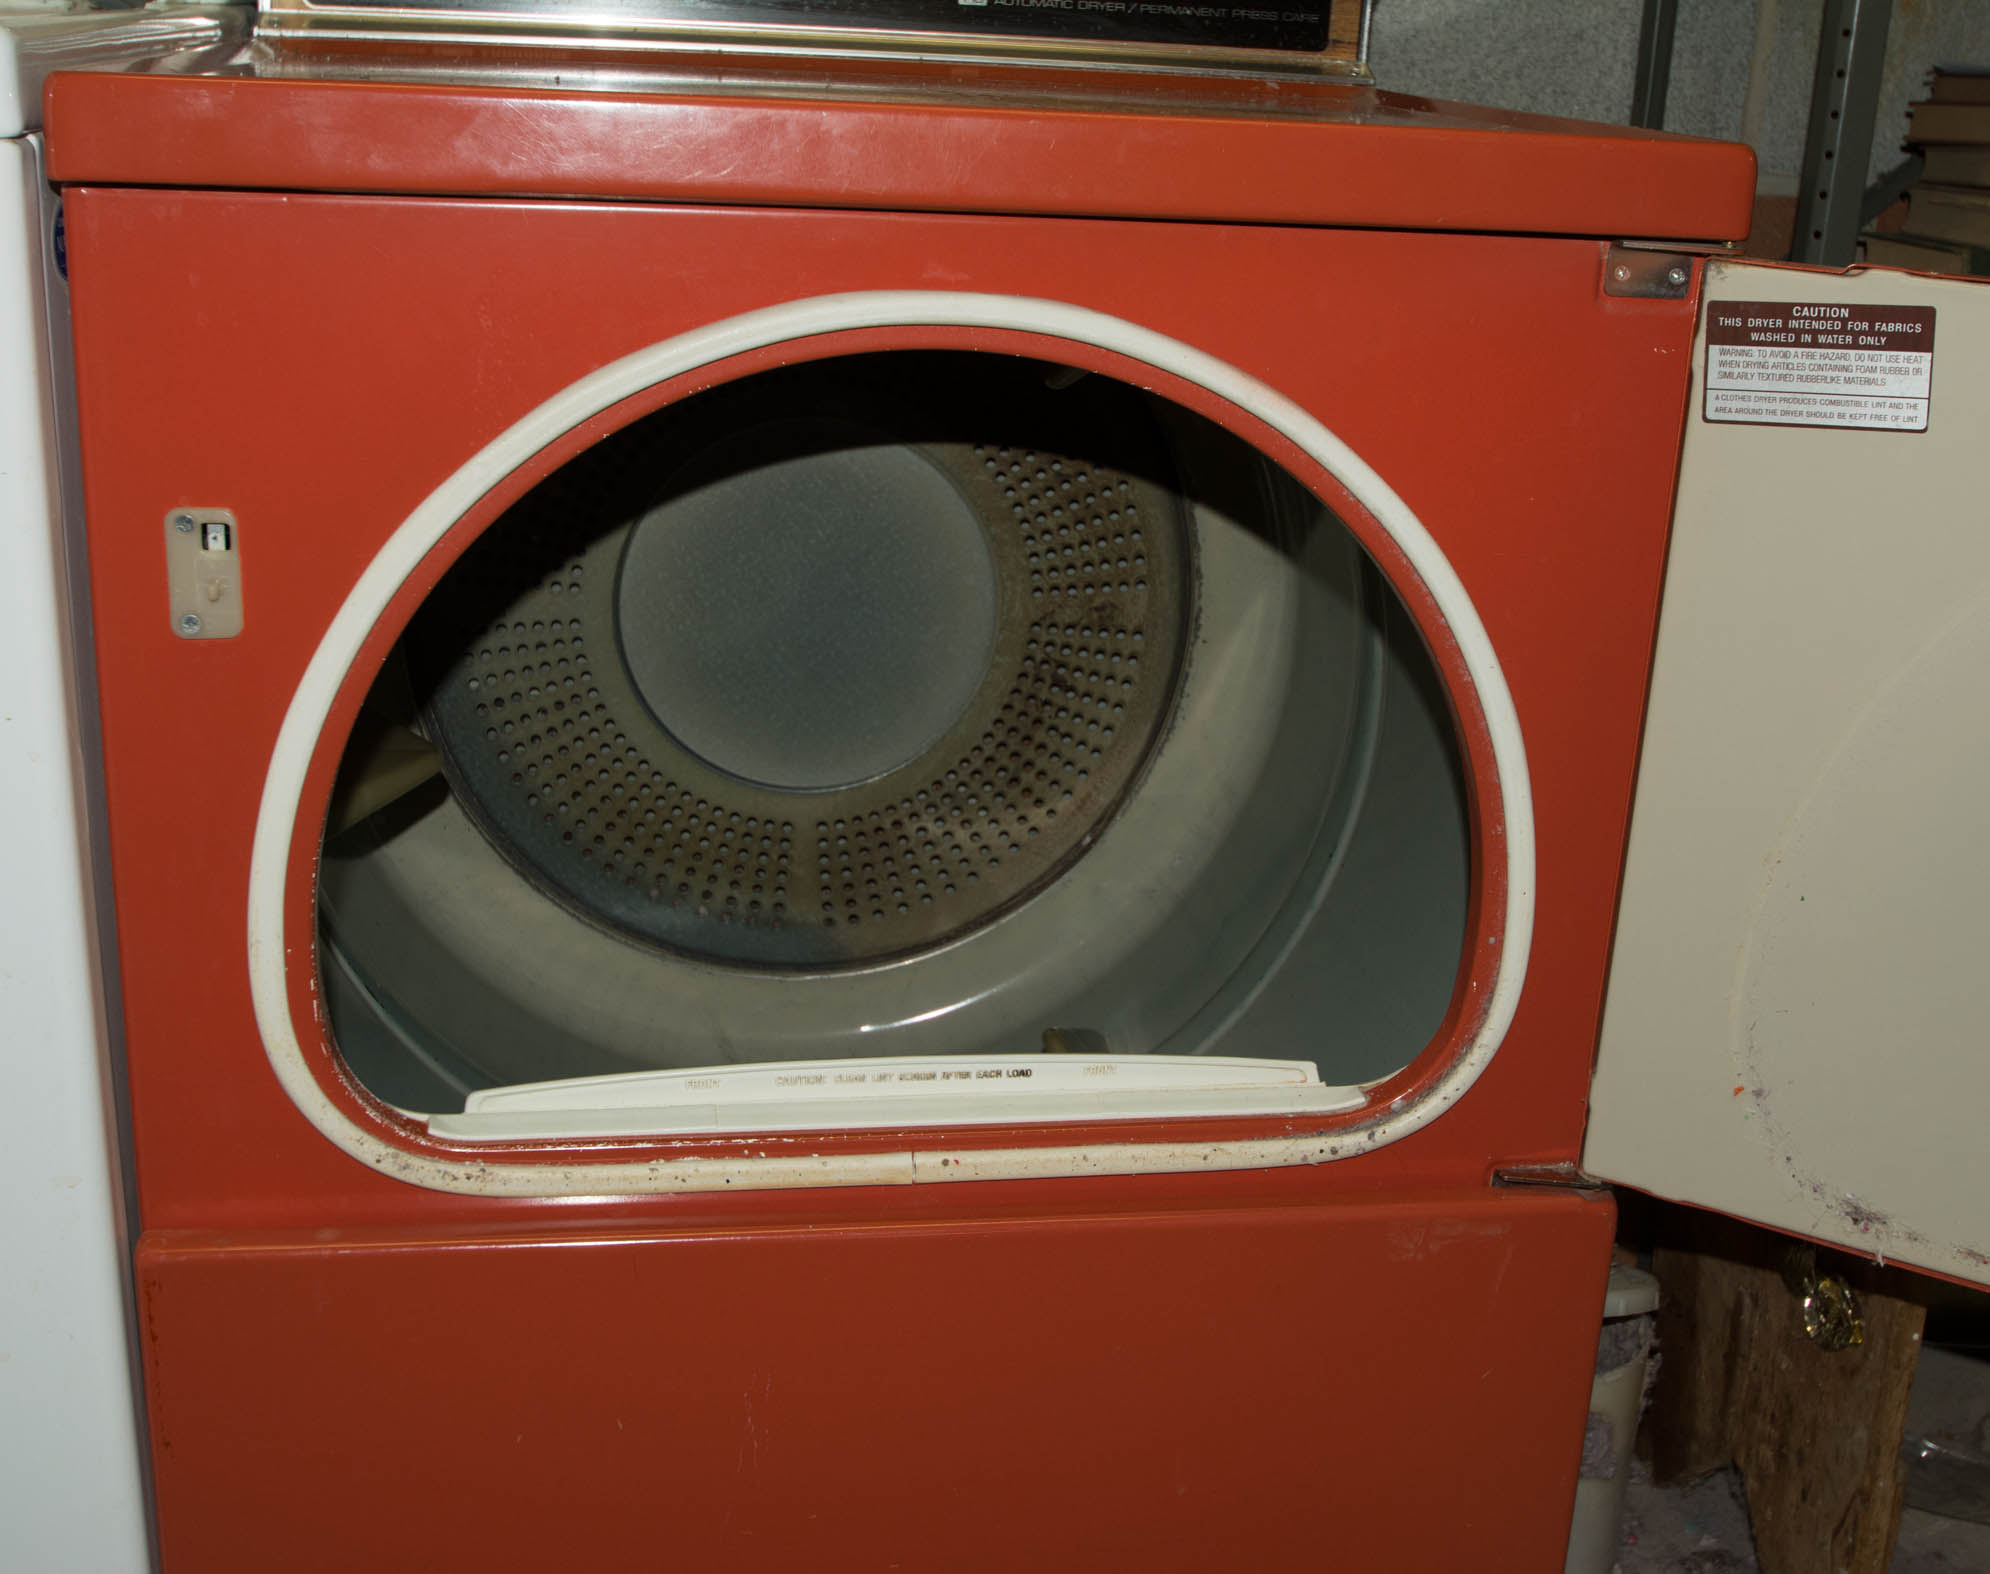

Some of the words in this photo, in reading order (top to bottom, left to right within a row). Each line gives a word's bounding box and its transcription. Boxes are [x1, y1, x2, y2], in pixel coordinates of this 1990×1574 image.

[1792, 306, 1849, 318] CAUTION
[1719, 317, 1742, 328] THIS
[1747, 318, 1782, 328] DRYER
[1788, 319, 1841, 330] INTENDED
[1847, 321, 1869, 331] FOR
[1874, 322, 1922, 333] FABRICS
[1750, 332, 1795, 343] WASHED
[1801, 333, 1811, 343] IN
[1818, 334, 1852, 345] WATER
[1858, 335, 1887, 346] ONLY
[1757, 349, 1767, 358] TO
[1769, 350, 1791, 359] AVOID
[1793, 351, 1799, 359] A
[1801, 351, 1817, 360] FIRE
[1854, 353, 1865, 362] DO
[1867, 353, 1883, 363] NOT
[1885, 354, 1902, 363] USE
[1903, 355, 1924, 364] HEAT
[1719, 360, 1740, 368] WHEN
[1742, 361, 1770, 370] DRYING
[1771, 362, 1806, 371] ARTICLES
[1808, 363, 1853, 373] CONTAINING
[1855, 365, 1877, 374] FOAM
[1880, 366, 1910, 376] RUBBER
[1912, 367, 1923, 376] OR
[1717, 371, 1755, 380] SIMILARLY
[1758, 372, 1794, 382] TEXTURED
[1796, 374, 1841, 384] RUBBERLIKE
[1721, 394, 1753, 402] CLOTHES
[1754, 395, 1777, 404] DRYER
[1779, 396, 1817, 405] PRODUCES
[1819, 398, 1868, 408] COMBUSTIBLE
[1871, 401, 1886, 409] LINT
[1888, 402, 1903, 410] AND
[1714, 406, 1733, 414] AREA
[1734, 407, 1762, 415] AROUND
[1780, 409, 1804, 417] DRYER
[1806, 411, 1835, 419] SHOULD
[1837, 412, 1846, 420] BE
[1849, 412, 1867, 420] KEPT
[976, 1069, 1002, 1079] EACH
[1006, 1068, 1032, 1078] LOAD
